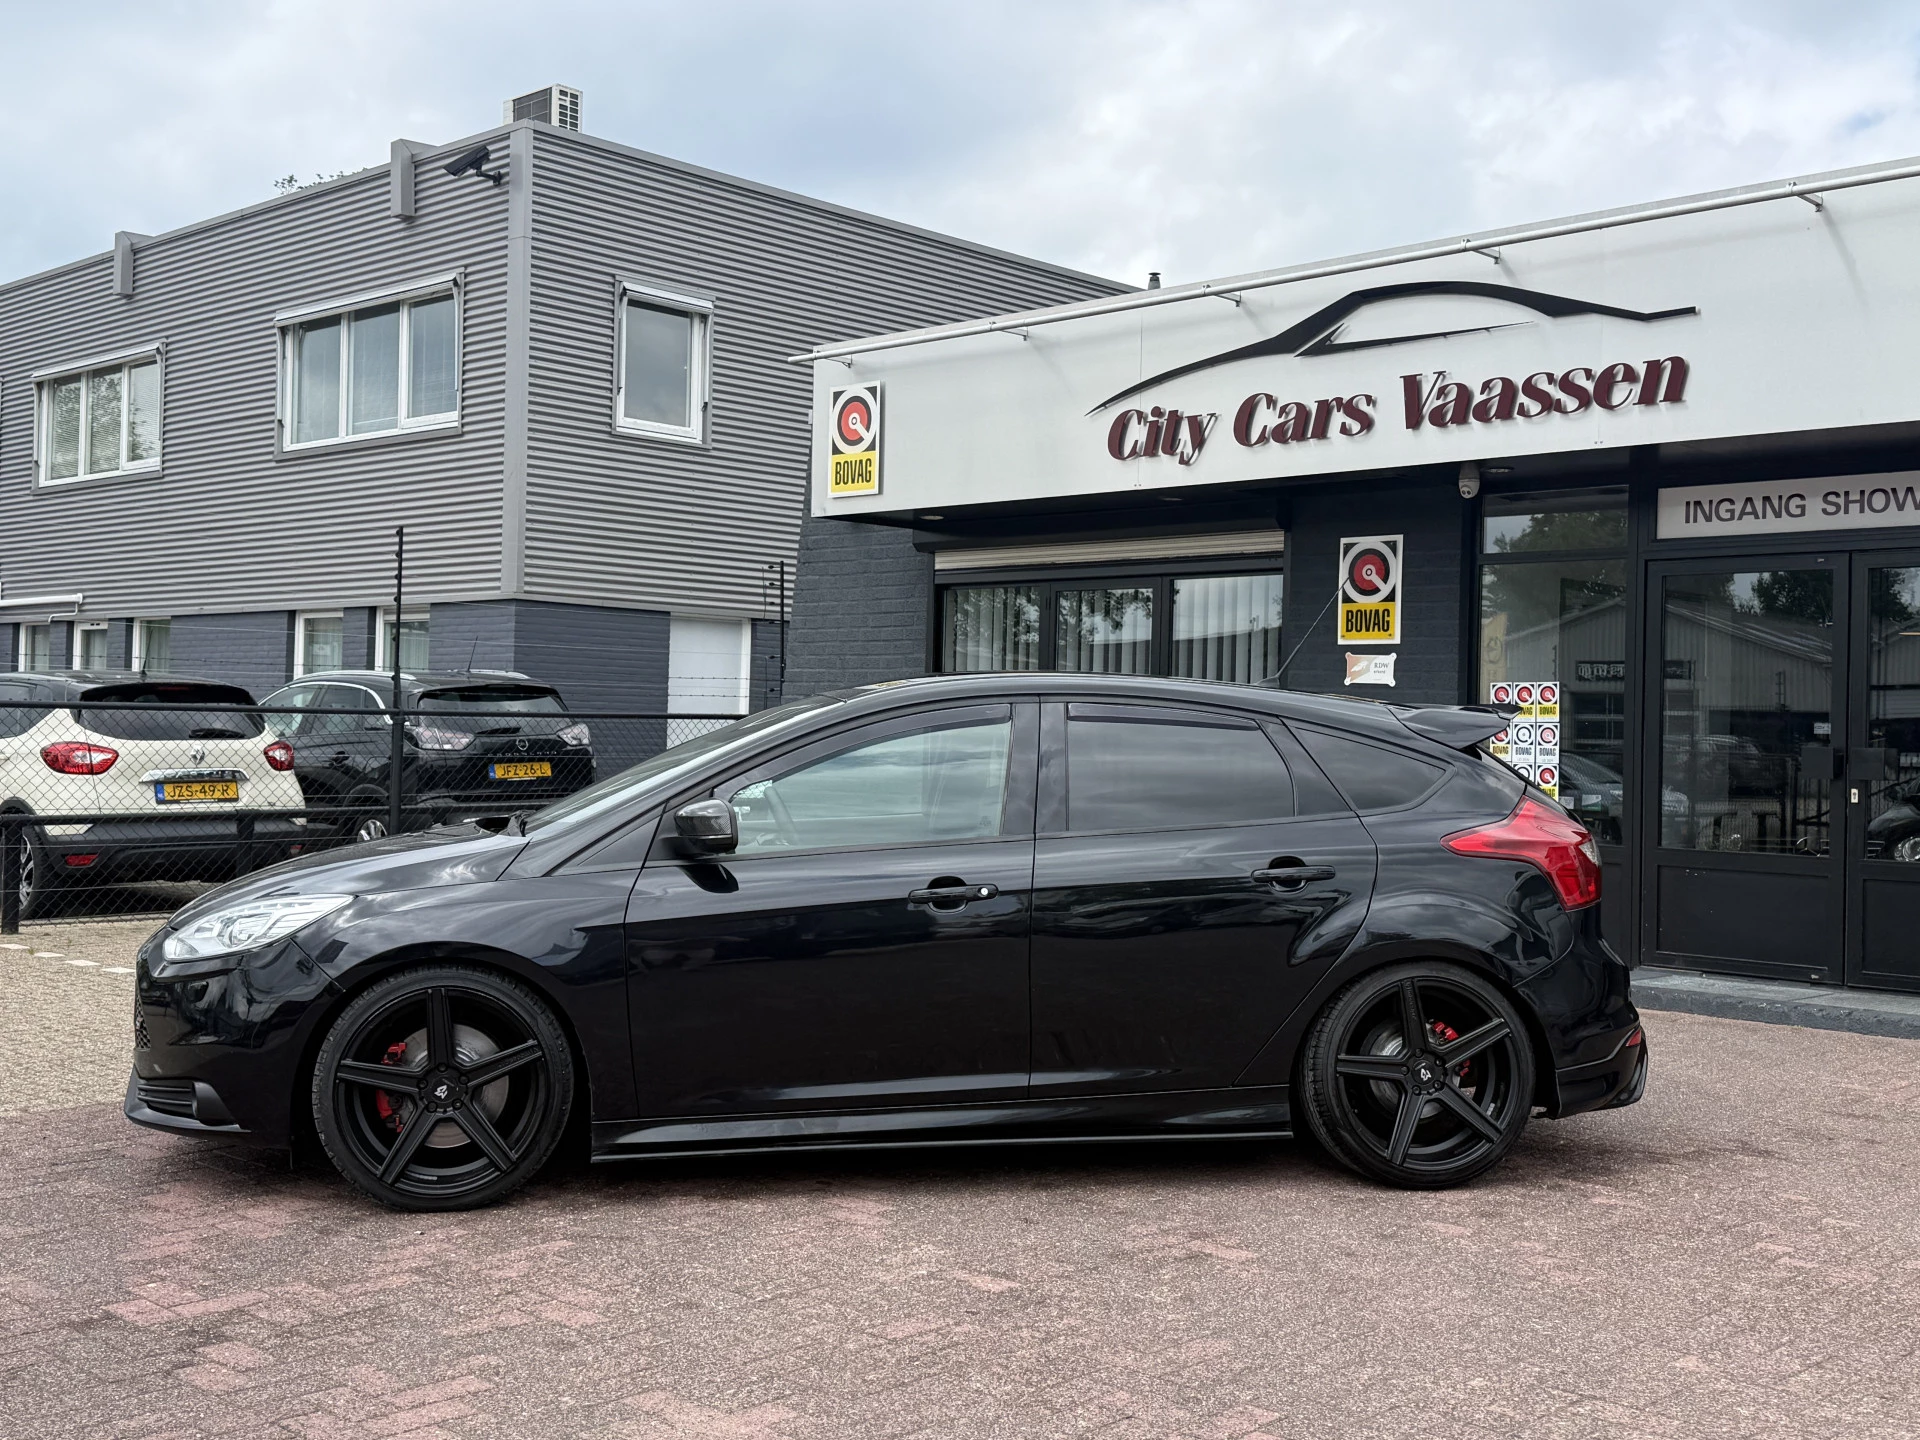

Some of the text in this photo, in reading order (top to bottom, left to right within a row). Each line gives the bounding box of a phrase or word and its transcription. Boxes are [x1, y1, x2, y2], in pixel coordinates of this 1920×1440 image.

[1107, 355, 1690, 466] City Cars Vaassen
[835, 458, 872, 486] BOVAG
[1684, 493, 1807, 524] INGANG
[1345, 608, 1391, 633] BOVAG
[1539, 706, 1557, 716] BOVAG
[1515, 747, 1532, 756] BOVAG
[1539, 748, 1557, 757] BOVAG
[501, 763, 546, 777] JFZ-26-L
[169, 784, 230, 798] JZS-49-R
